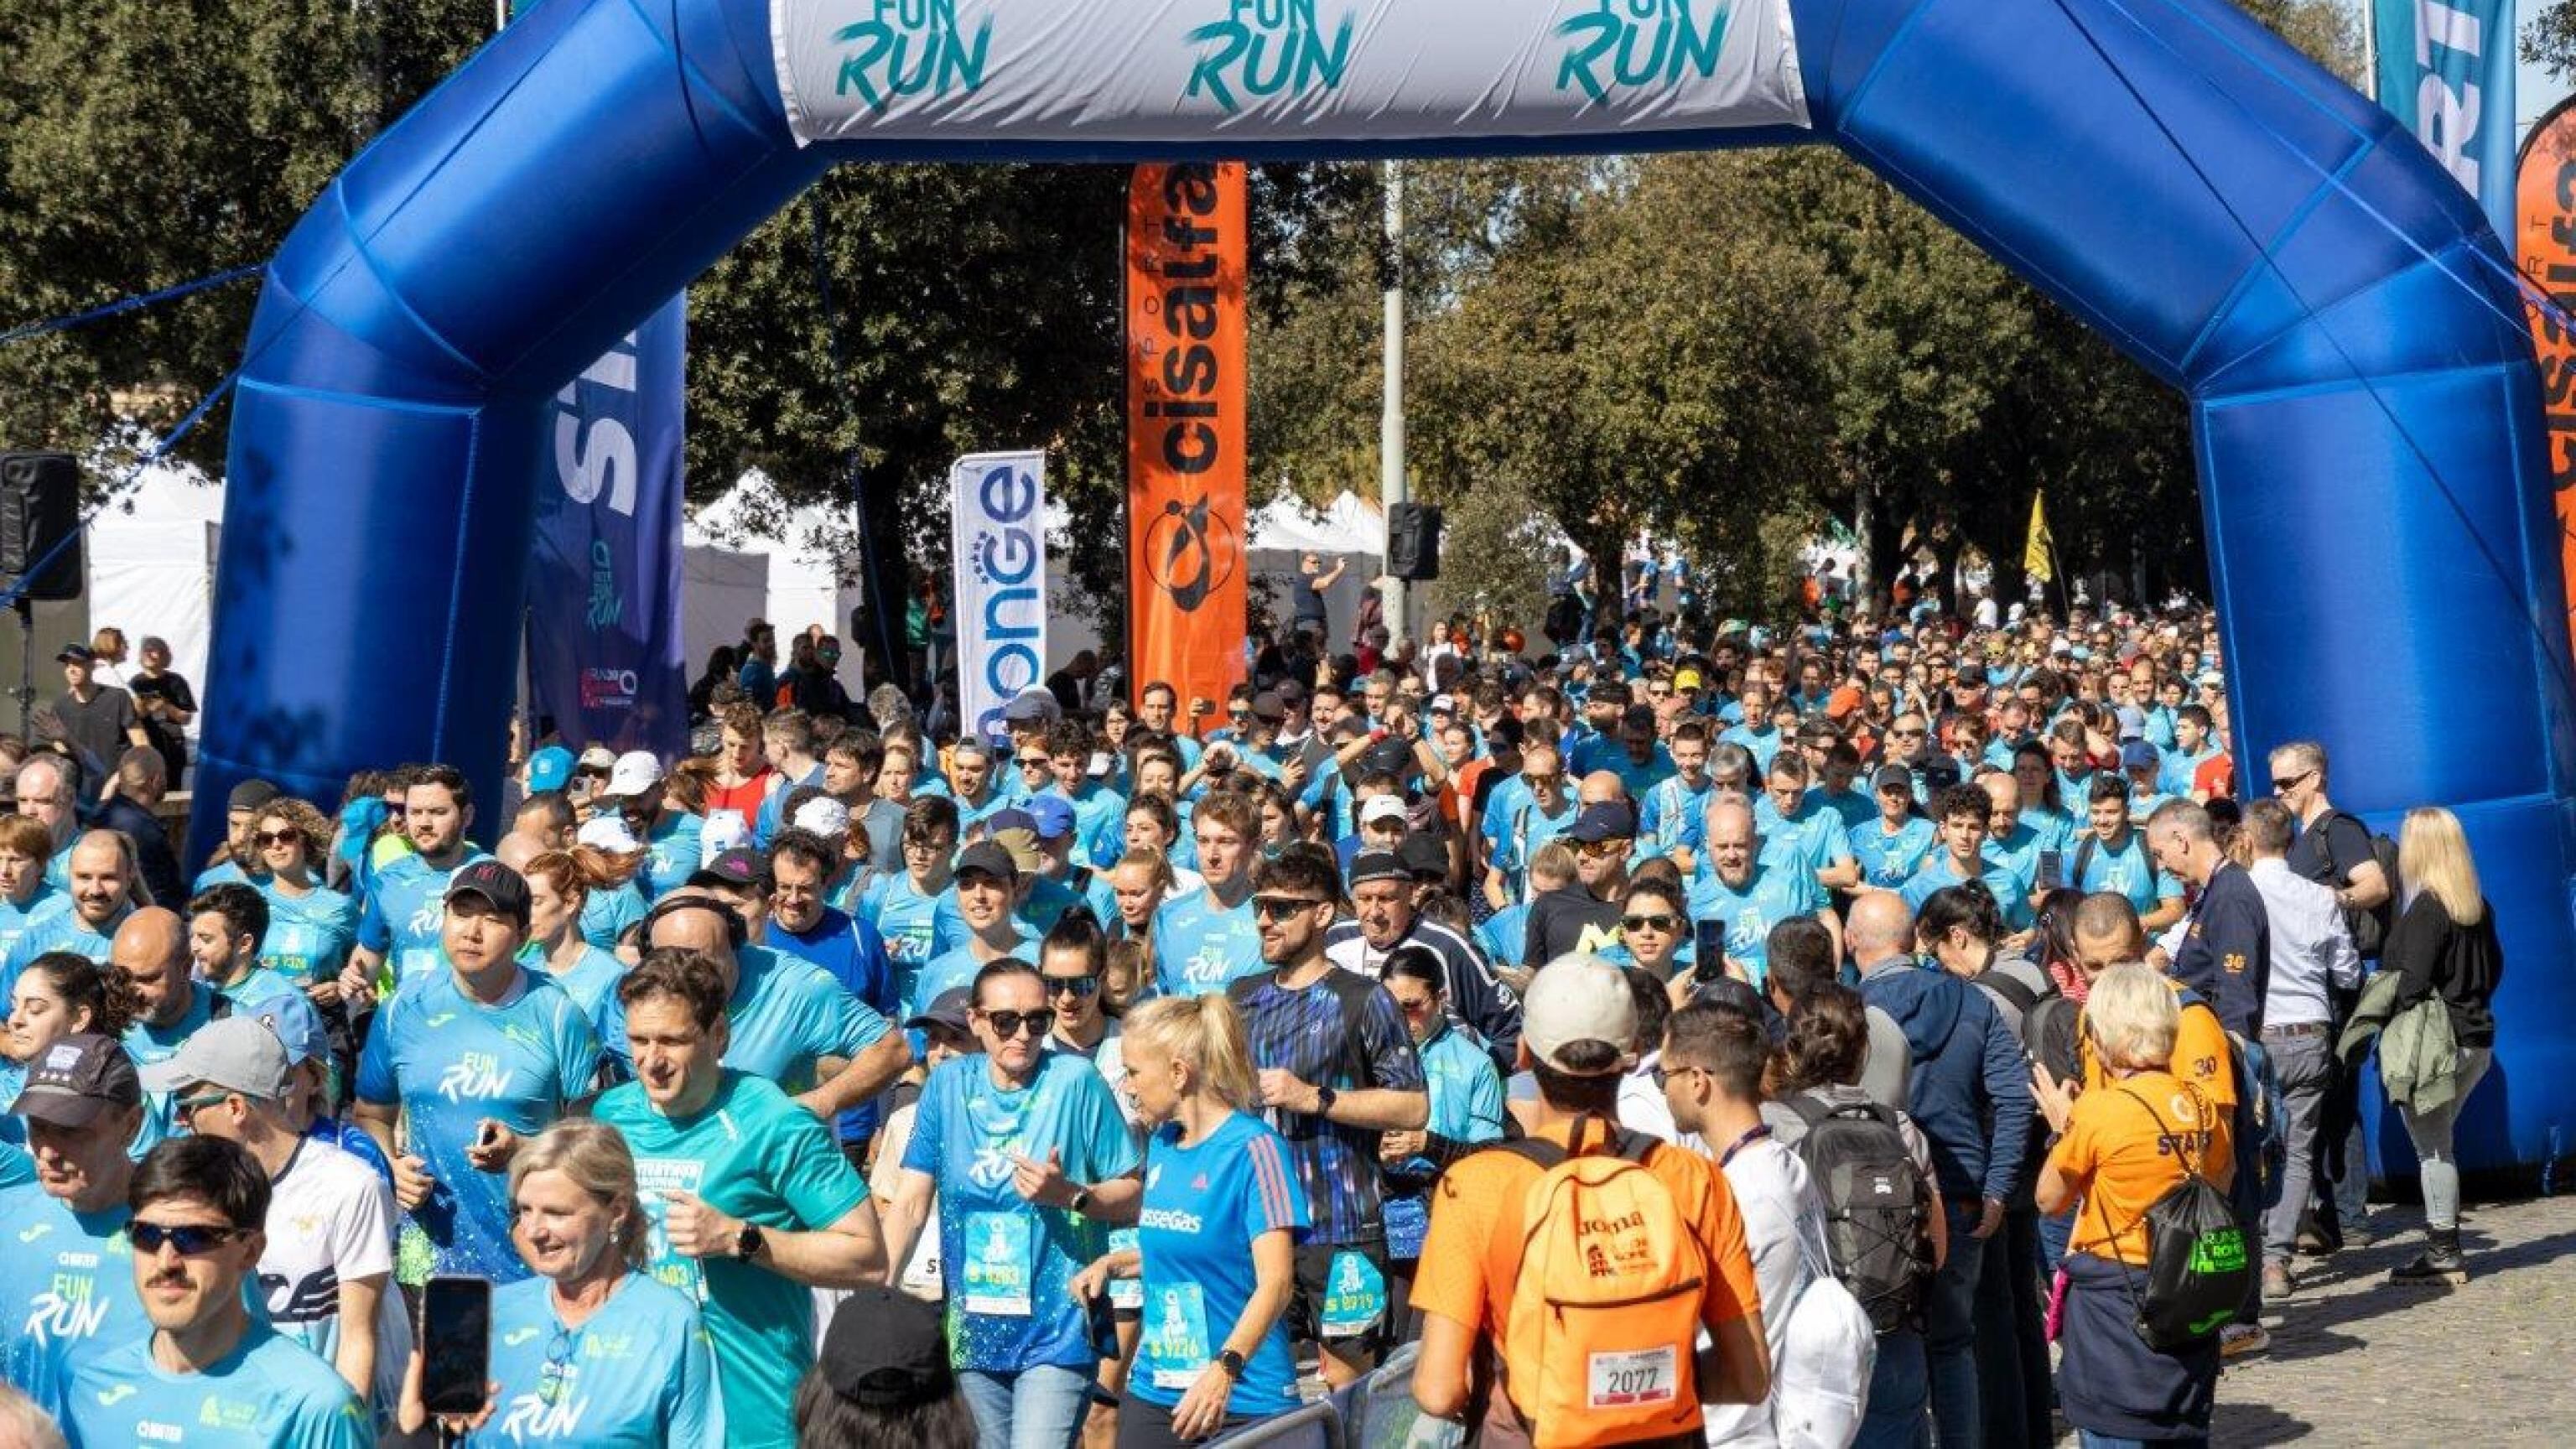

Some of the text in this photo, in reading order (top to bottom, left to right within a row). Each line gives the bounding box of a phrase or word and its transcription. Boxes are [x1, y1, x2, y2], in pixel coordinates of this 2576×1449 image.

[833, 12, 995, 114] RUN
[1186, 10, 1353, 112] RUN
[1555, 5, 1731, 104] RUN
[1143, 162, 1218, 473] cisalfa
[1144, 216, 1160, 395] SPORT
[408, 906, 444, 938] RU
[1182, 956, 1230, 987] RUN
[437, 1063, 514, 1105] RUN
[464, 1051, 498, 1074] FUN
[2194, 1056, 2217, 1078] 30
[54, 1273, 95, 1300] FUN
[23, 1291, 110, 1349] RUN
[1608, 1366, 1659, 1393] 2077
[500, 1392, 589, 1446] RUN
